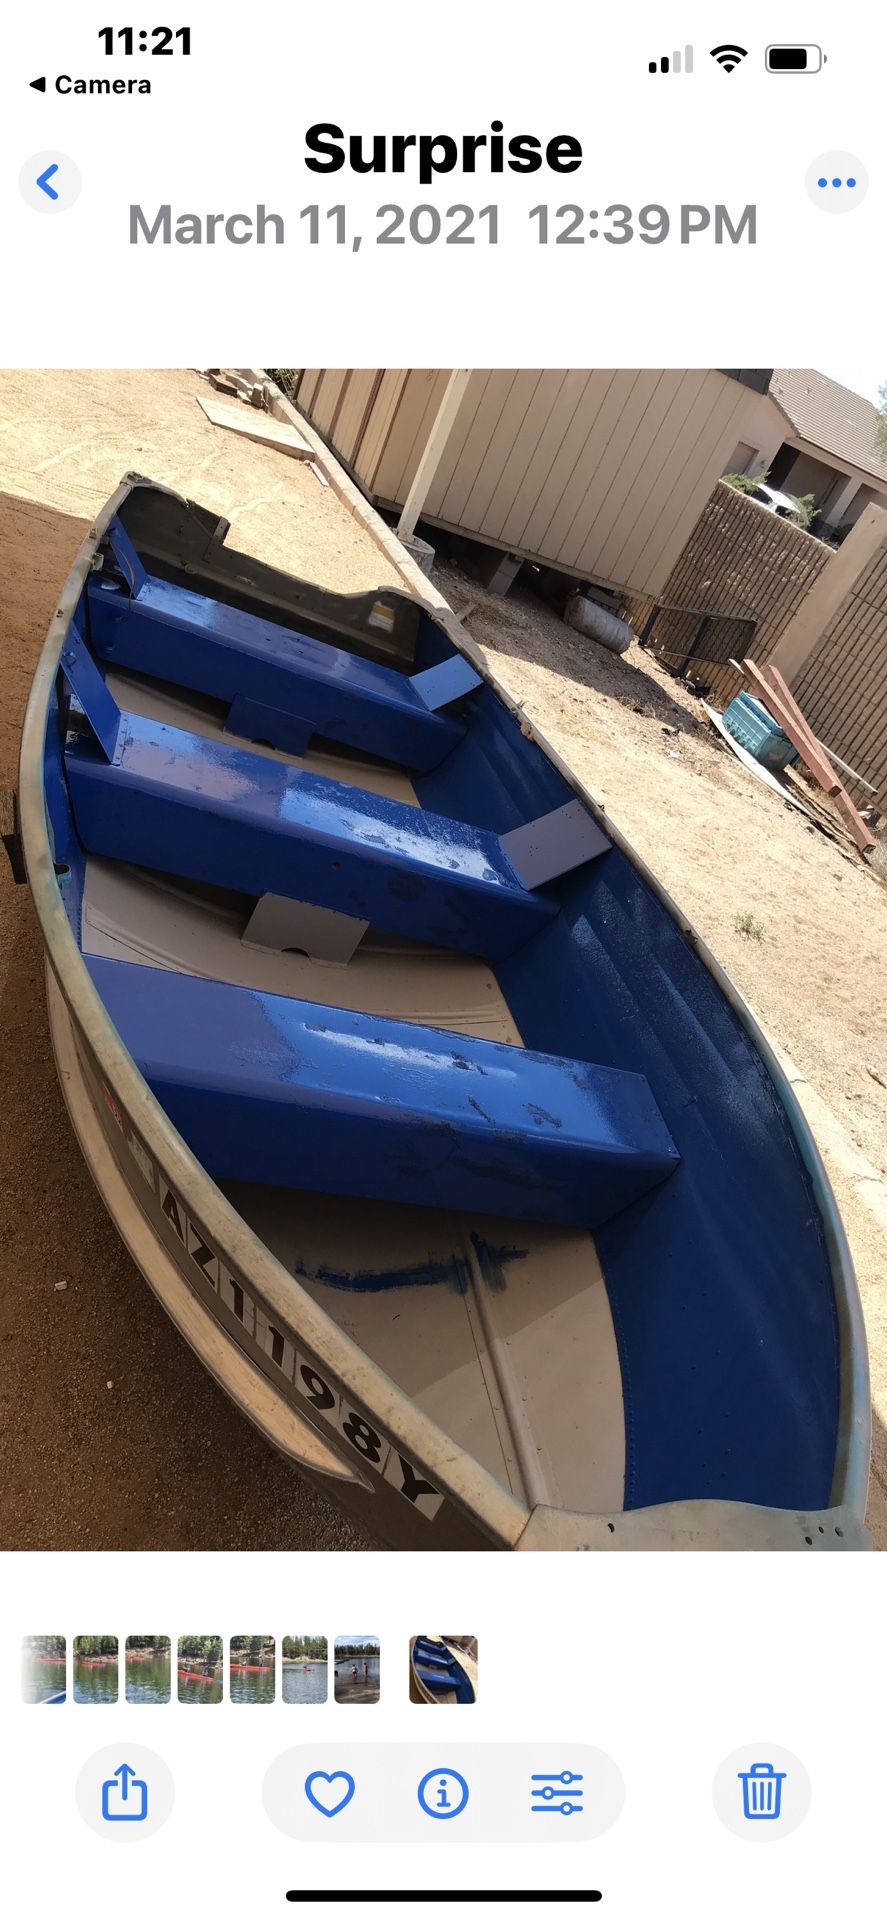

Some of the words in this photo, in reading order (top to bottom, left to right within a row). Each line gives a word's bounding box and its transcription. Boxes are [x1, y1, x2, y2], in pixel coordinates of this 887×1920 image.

[97, 26, 191, 55] 11:21
[54, 74, 151, 94] Camera
[303, 119, 583, 184] Surprise
[129, 203, 285, 245] March
[299, 203, 363, 252] 11,
[375, 203, 498, 245] 2021
[528, 203, 670, 245] 12:39
[680, 203, 757, 245] PM
